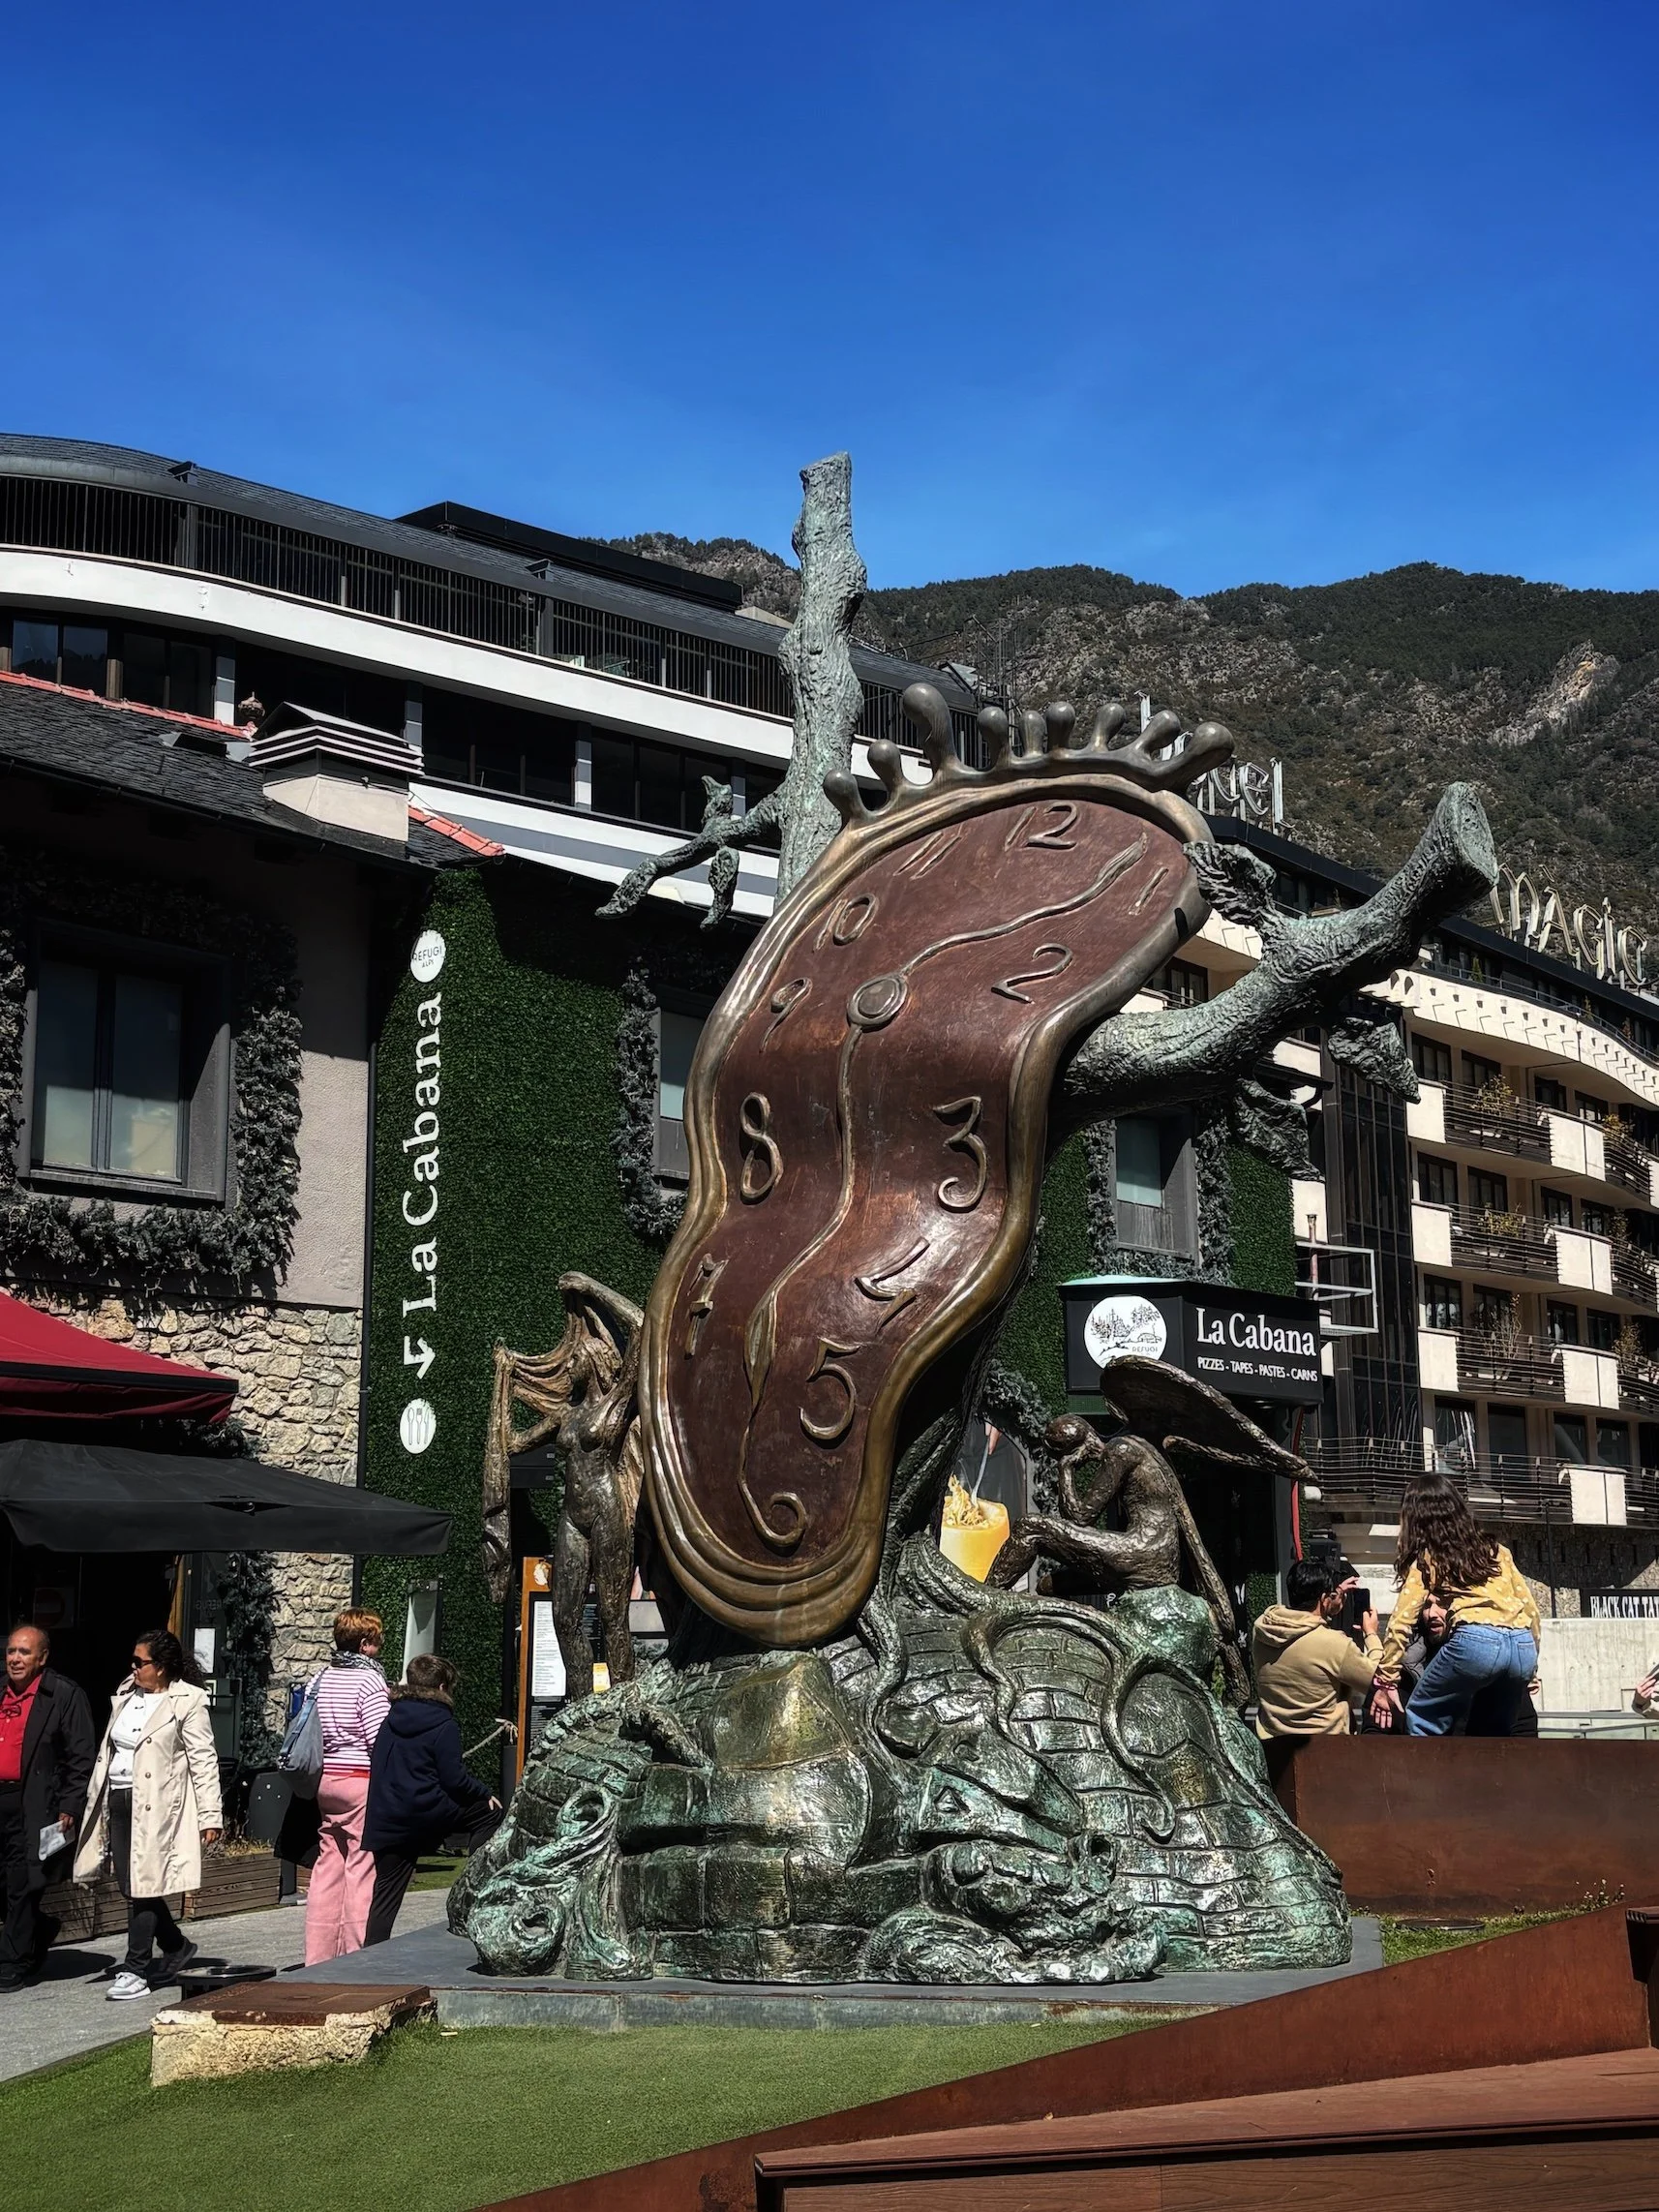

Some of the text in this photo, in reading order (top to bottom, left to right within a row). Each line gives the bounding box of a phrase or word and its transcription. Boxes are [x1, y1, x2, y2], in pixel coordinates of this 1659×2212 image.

[403, 992, 442, 1318] La Cabana
[740, 1092, 784, 1198] 8
[933, 1096, 987, 1208] 3
[1195, 1307, 1317, 1356] La Cabana
[1197, 1356, 1317, 1381] PIZZES TAPES PASTES CARNS
[799, 1336, 861, 1439] 5
[1589, 1595, 1620, 1618] BLACK
[1622, 1595, 1641, 1618] CAT
